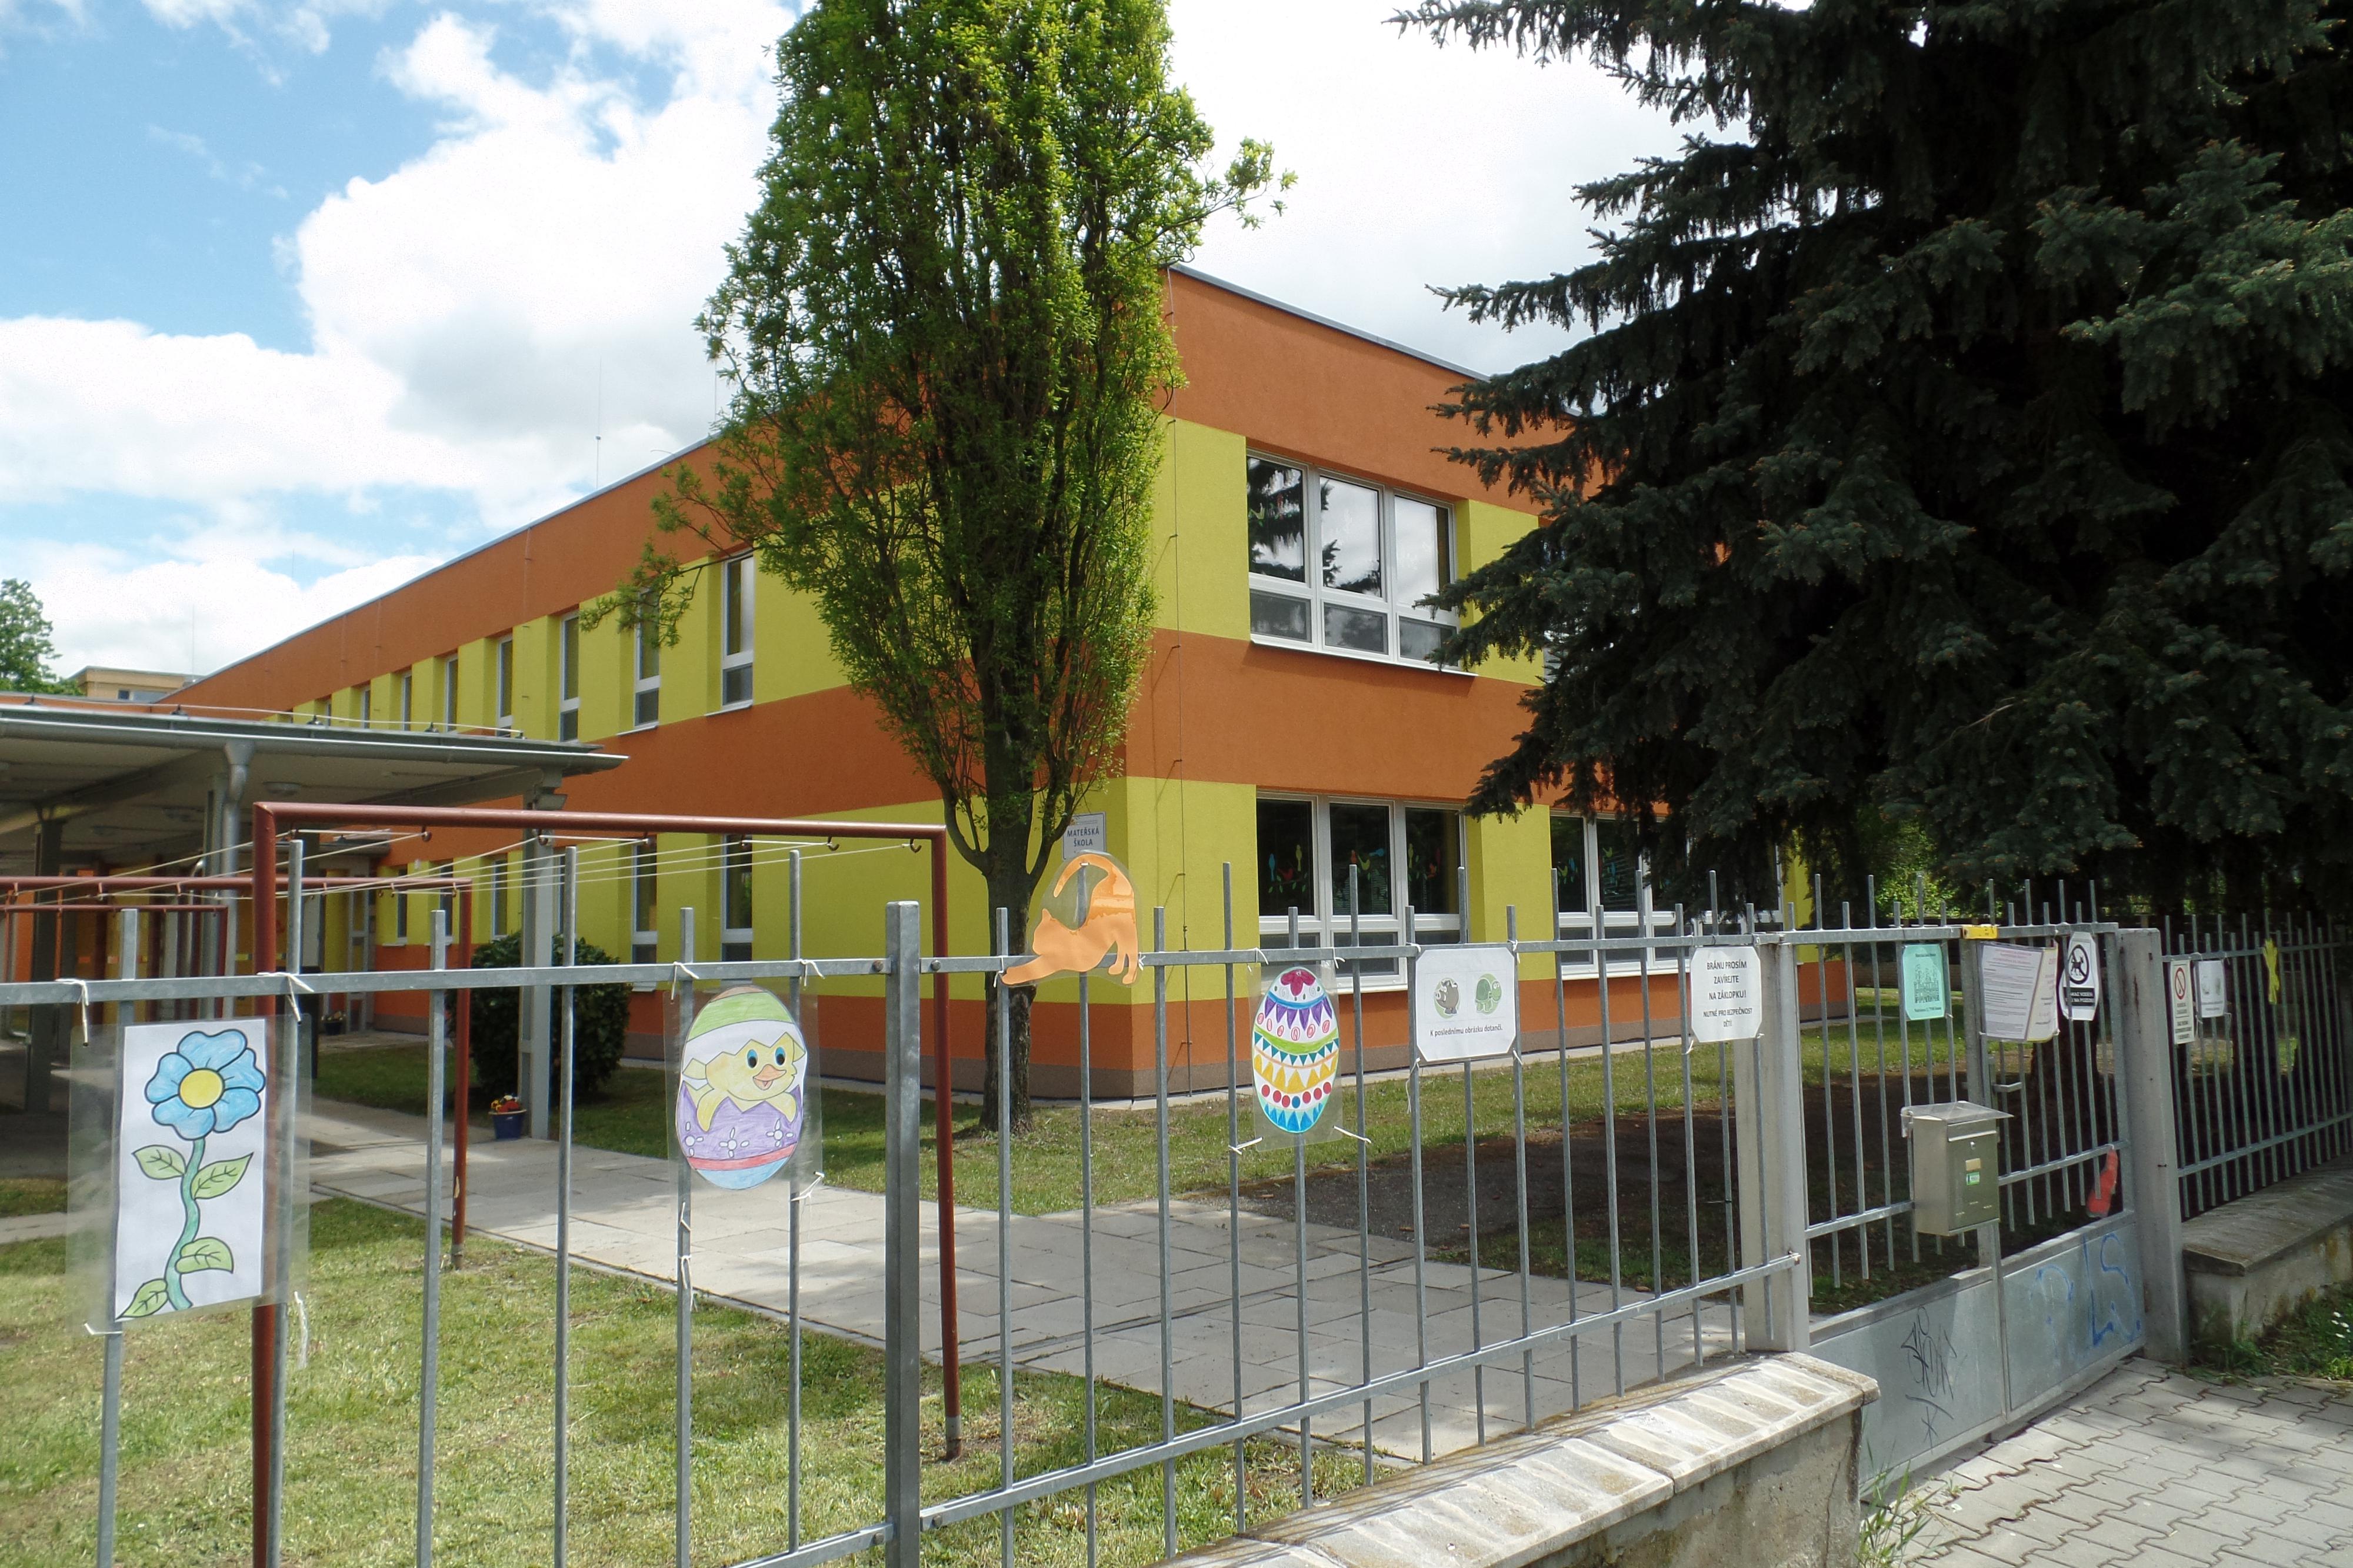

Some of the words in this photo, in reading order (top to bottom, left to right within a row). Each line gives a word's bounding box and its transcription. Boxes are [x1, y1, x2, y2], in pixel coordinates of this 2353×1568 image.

[1067, 826, 1099, 837] MATEŘSKÁ
[1074, 838, 1093, 847] ŠKOLA
[1707, 960, 1724, 970] BRÁNU
[1725, 959, 1747, 969] PROSÍM
[1718, 989, 1747, 999] ZÁKLOPKU!
[1703, 1009, 1717, 1017] NUTNÉ
[1435, 1027, 1464, 1037] poslednímu
